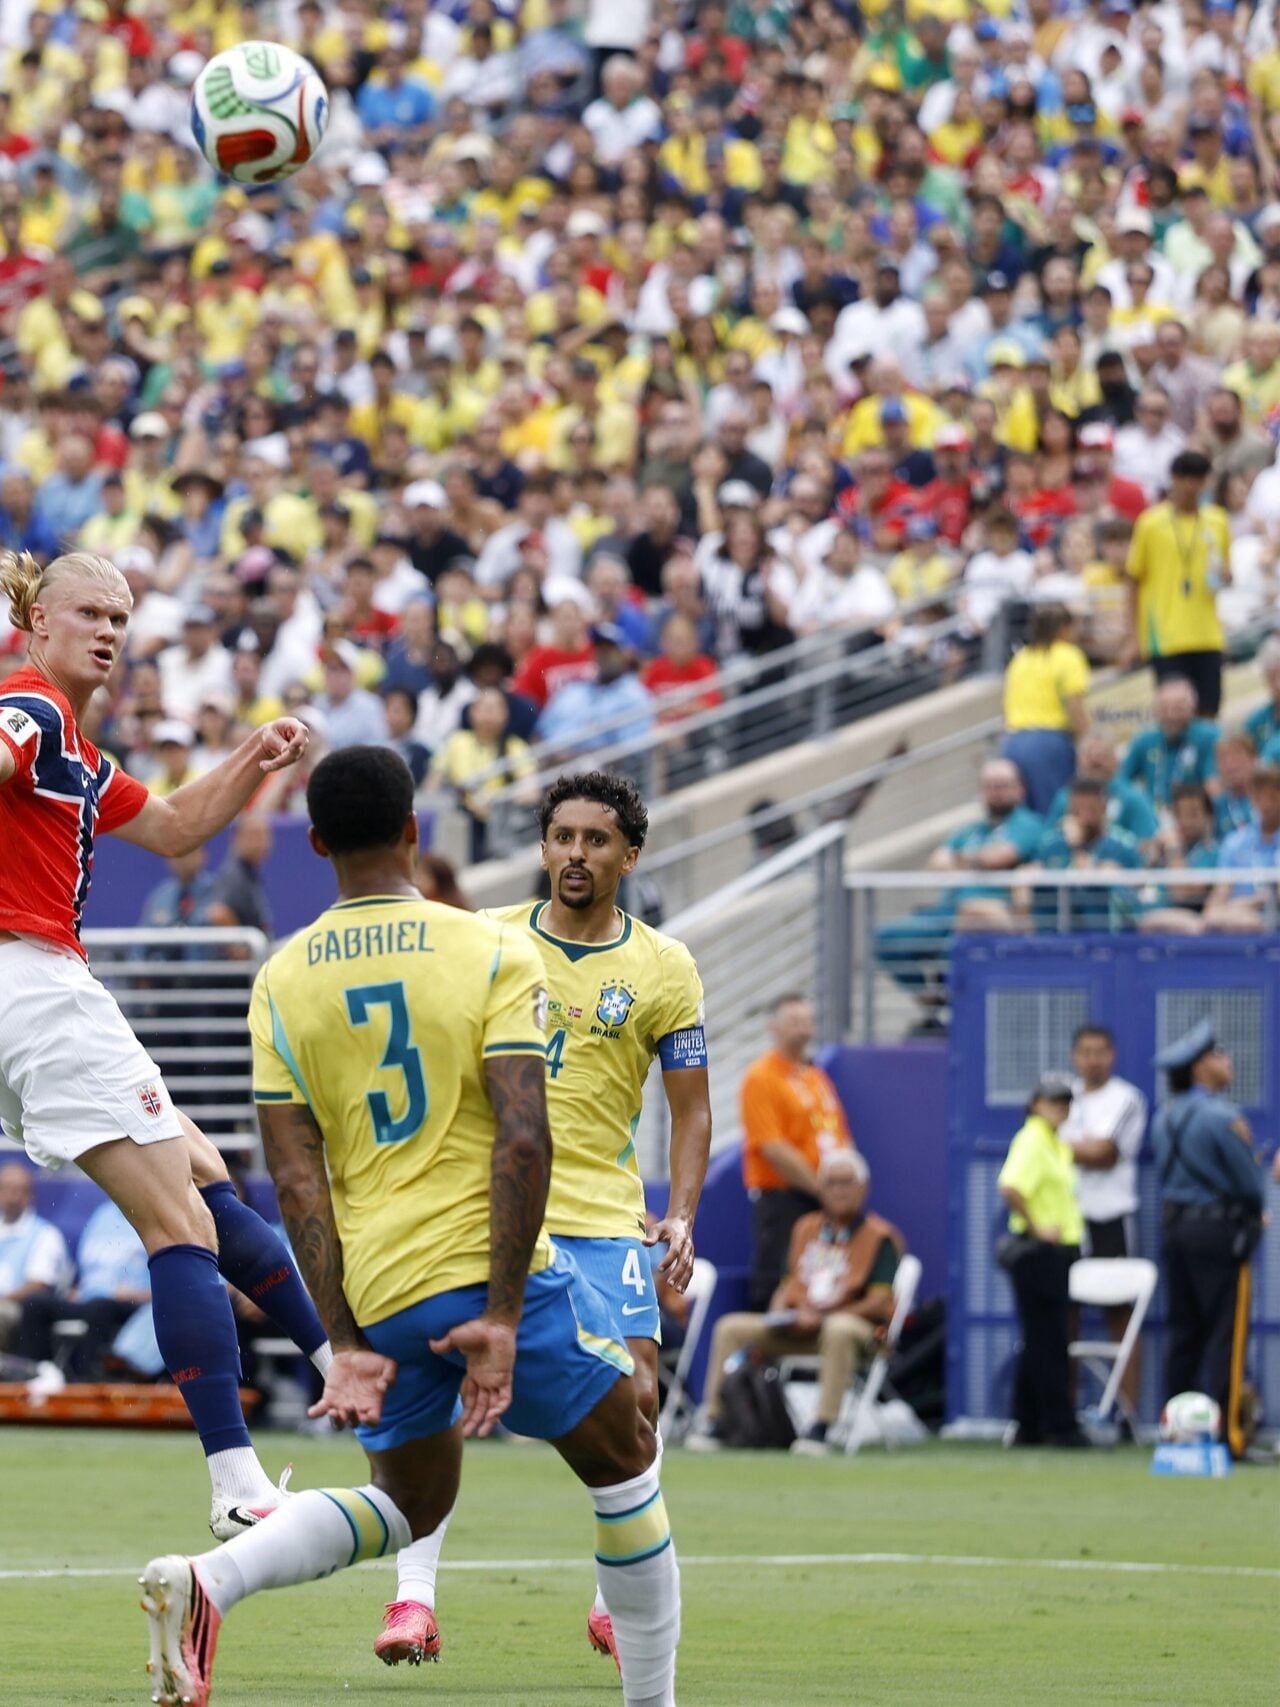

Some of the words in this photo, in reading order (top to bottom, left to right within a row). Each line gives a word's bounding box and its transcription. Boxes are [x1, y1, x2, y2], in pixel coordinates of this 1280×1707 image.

[308, 920, 435, 966] GABRIEL
[546, 1028, 566, 1079] 4
[590, 1025, 621, 1040] BRASIL
[673, 1029, 703, 1040] FOOTBALL
[674, 1037, 704, 1050] UNITES
[345, 979, 428, 1144] 3
[621, 1248, 647, 1296] 4
